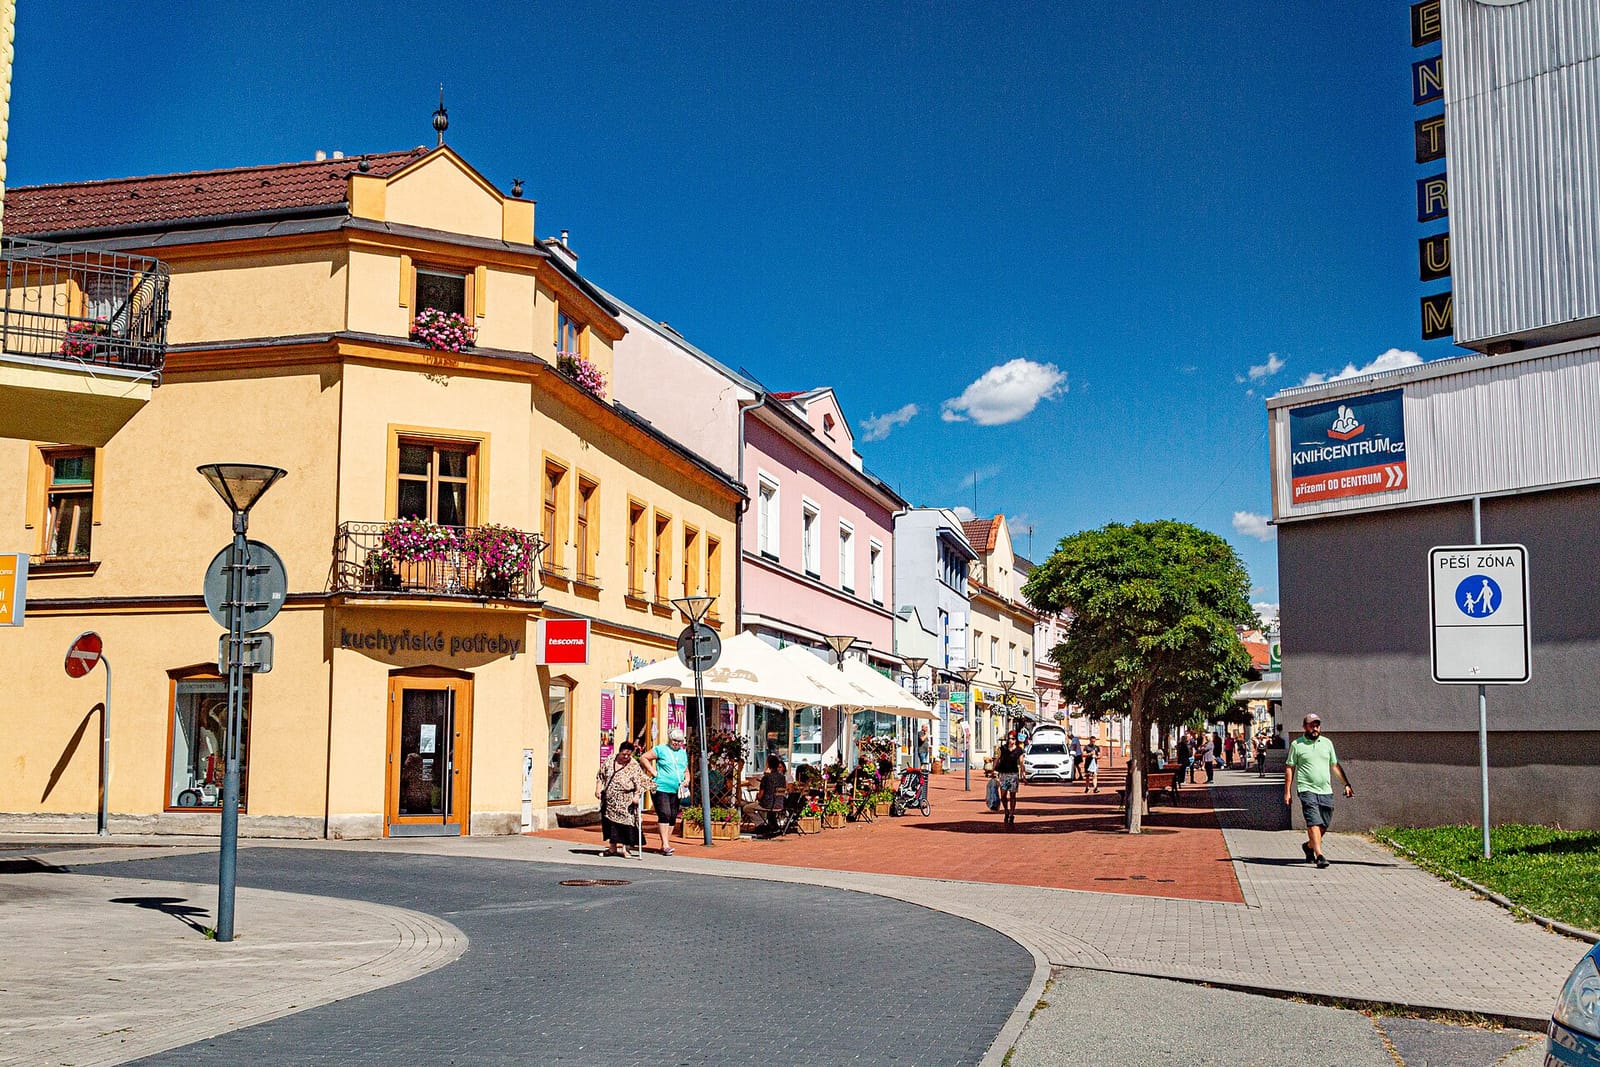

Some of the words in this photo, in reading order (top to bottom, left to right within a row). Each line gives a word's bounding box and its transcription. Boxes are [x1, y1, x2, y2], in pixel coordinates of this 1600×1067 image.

[1295, 480, 1326, 497] přízemí
[1327, 479, 1339, 490] OD
[1341, 472, 1382, 489] CENTRUM
[1440, 554, 1470, 569] PĚŠÍ
[1477, 554, 1515, 568] ZÓNA
[341, 628, 445, 655] kuchyňské
[450, 633, 521, 660] potřeby
